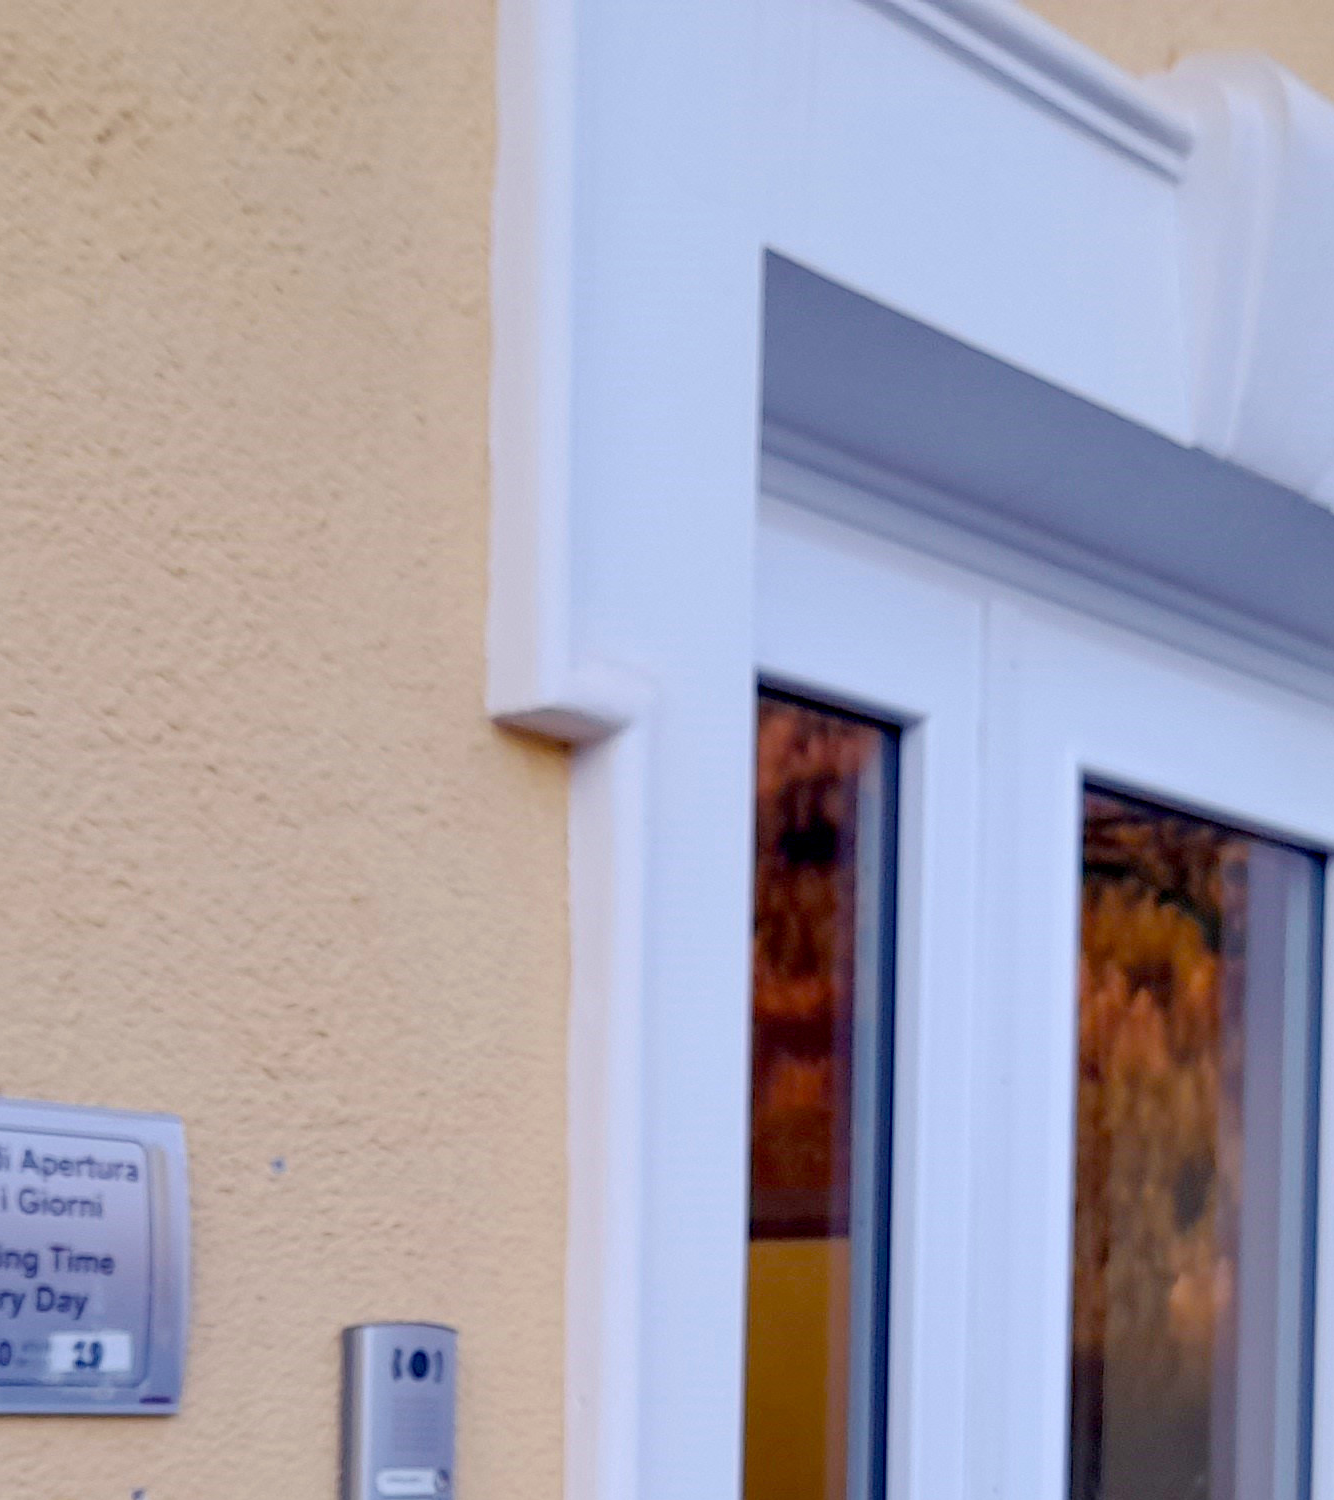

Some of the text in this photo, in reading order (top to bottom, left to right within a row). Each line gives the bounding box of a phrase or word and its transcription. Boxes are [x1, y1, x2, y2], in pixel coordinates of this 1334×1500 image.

[21, 1149, 139, 1182] Apertura
[18, 1188, 103, 1218] Giorni
[50, 1245, 116, 1276] Time
[35, 1285, 88, 1320] Day
